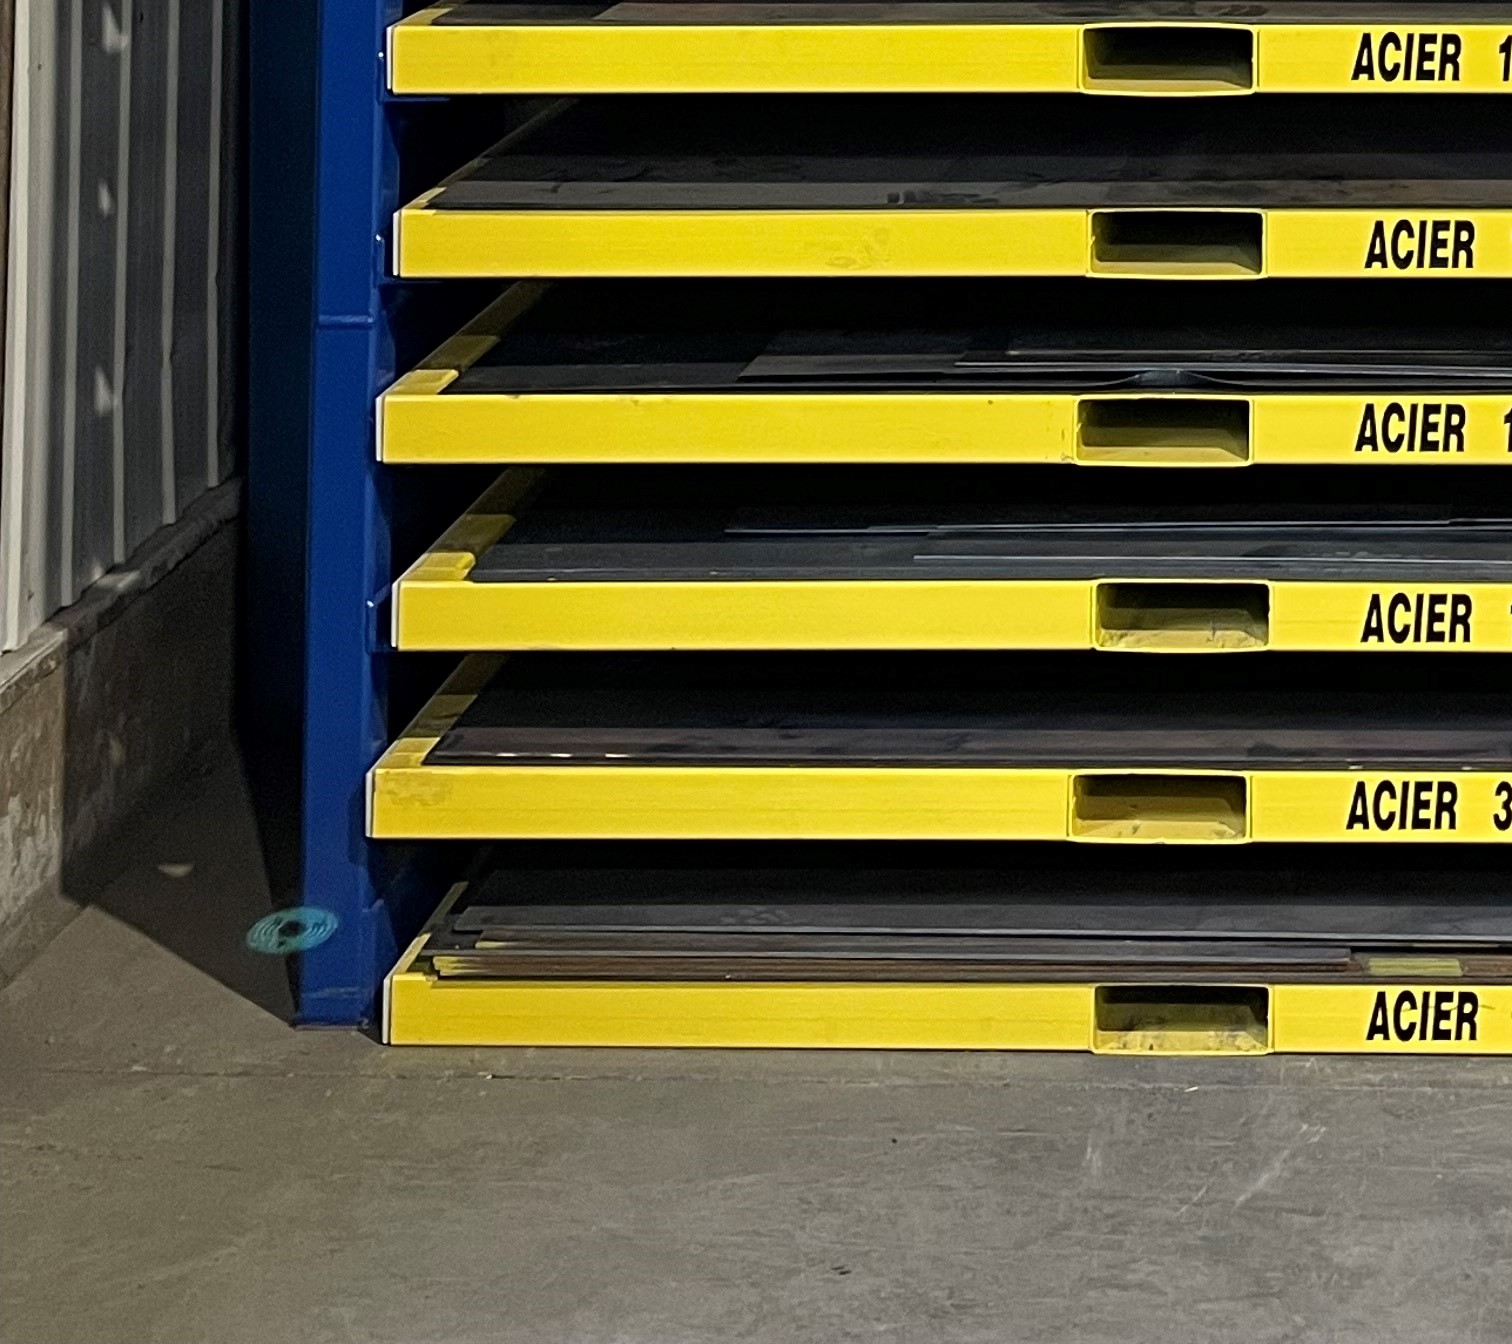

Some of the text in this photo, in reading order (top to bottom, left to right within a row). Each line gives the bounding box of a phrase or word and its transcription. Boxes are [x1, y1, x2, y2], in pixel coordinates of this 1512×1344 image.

[1351, 31, 1462, 83] ACIER
[1364, 218, 1476, 271] ACIER
[1354, 402, 1467, 454] ACIER
[1360, 592, 1473, 645] ACIER
[1345, 779, 1459, 832] ACIER
[1366, 989, 1479, 1043] ACIER
